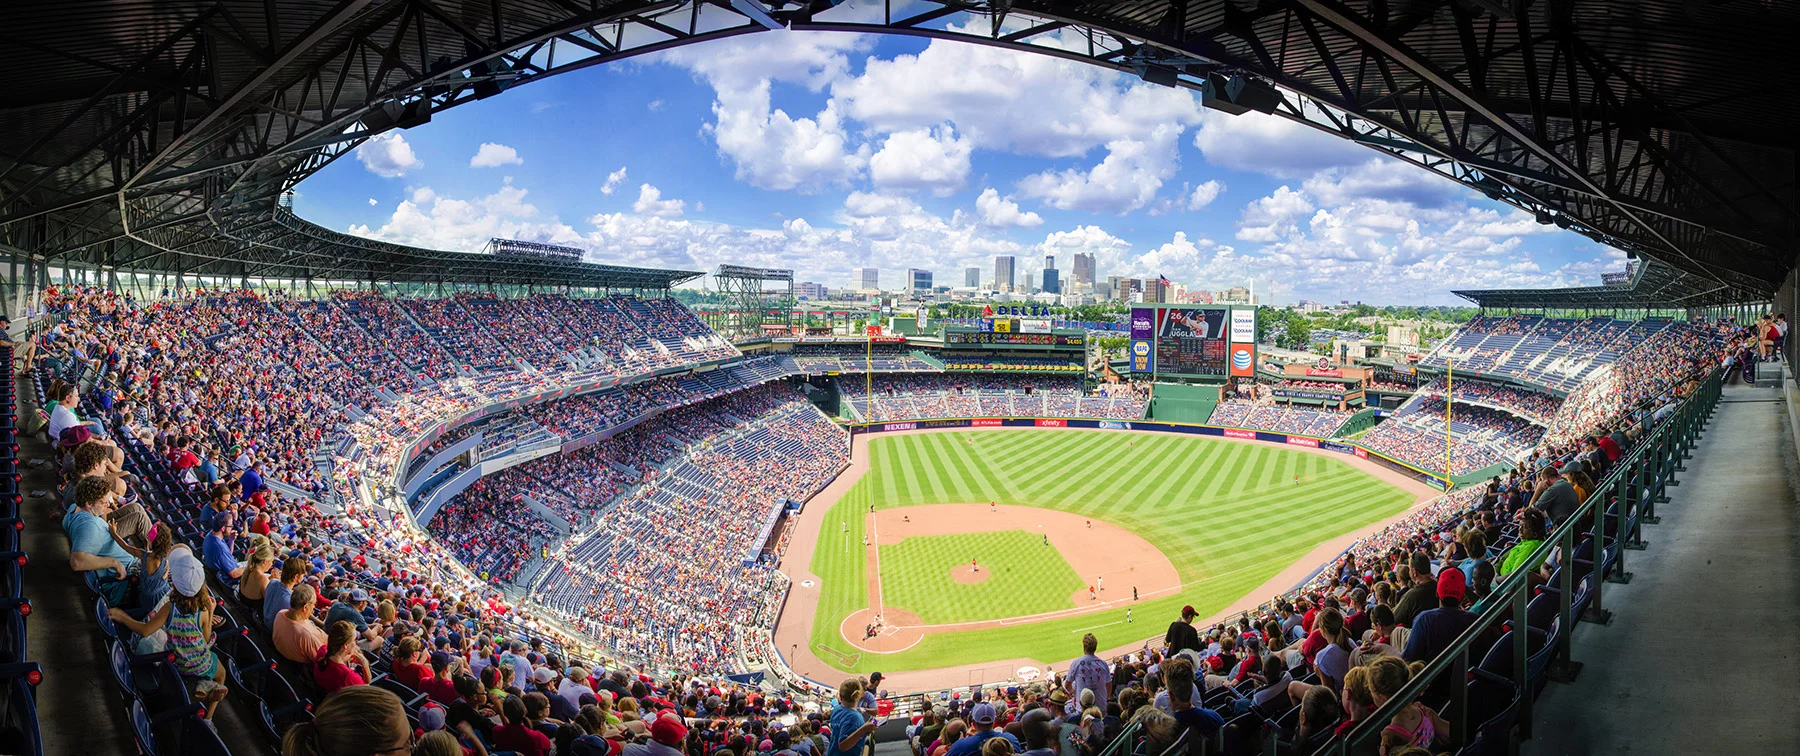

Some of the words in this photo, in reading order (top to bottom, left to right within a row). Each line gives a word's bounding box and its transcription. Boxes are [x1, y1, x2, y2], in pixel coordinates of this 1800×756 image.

[997, 305, 1050, 317] DELTA
[1170, 312, 1182, 320] 26
[1171, 330, 1194, 338] UGGLA
[884, 423, 911, 431] NEXEN
